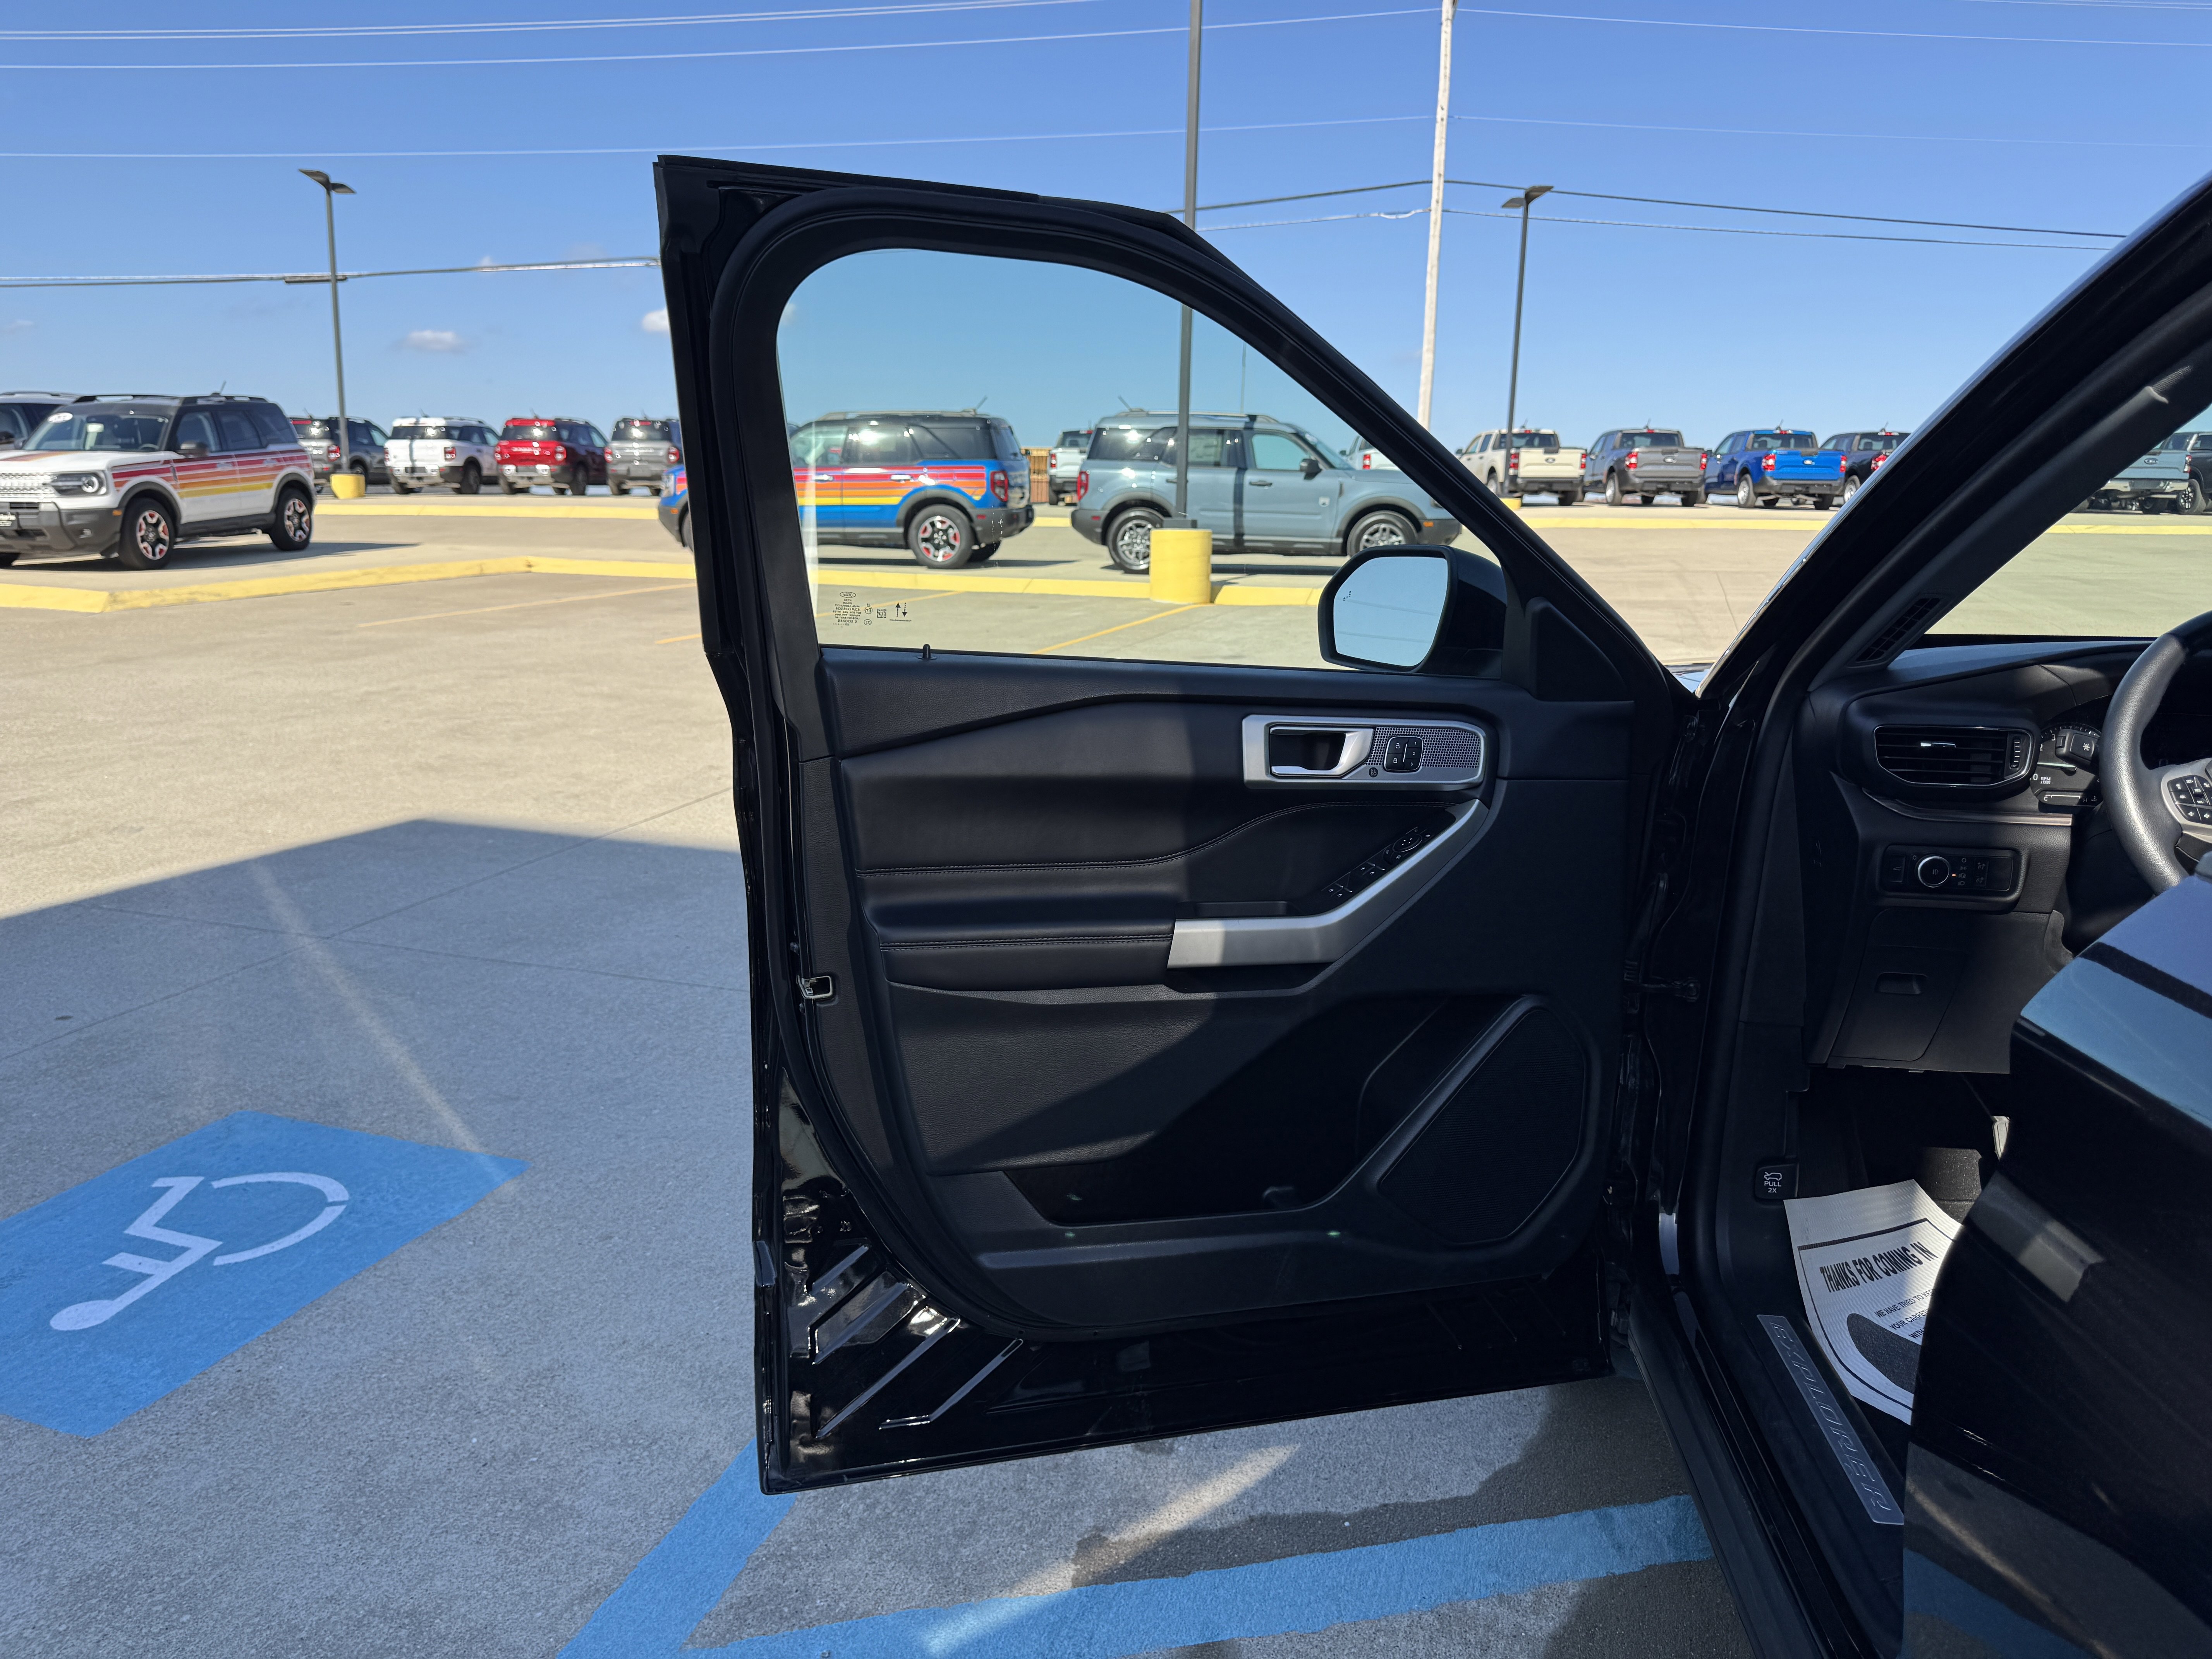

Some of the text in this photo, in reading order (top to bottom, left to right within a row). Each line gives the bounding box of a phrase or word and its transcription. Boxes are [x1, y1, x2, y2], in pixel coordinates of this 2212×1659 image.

[1820, 1241, 1939, 1293] THANKS FOR COMING IN
[1874, 1310, 1887, 1318] WE
[1883, 1304, 1901, 1314] HAVE
[1898, 1298, 1916, 1308] TRIED
[1889, 1320, 1908, 1330] YOUR
[1769, 1322, 1891, 1511] EXPLORER
